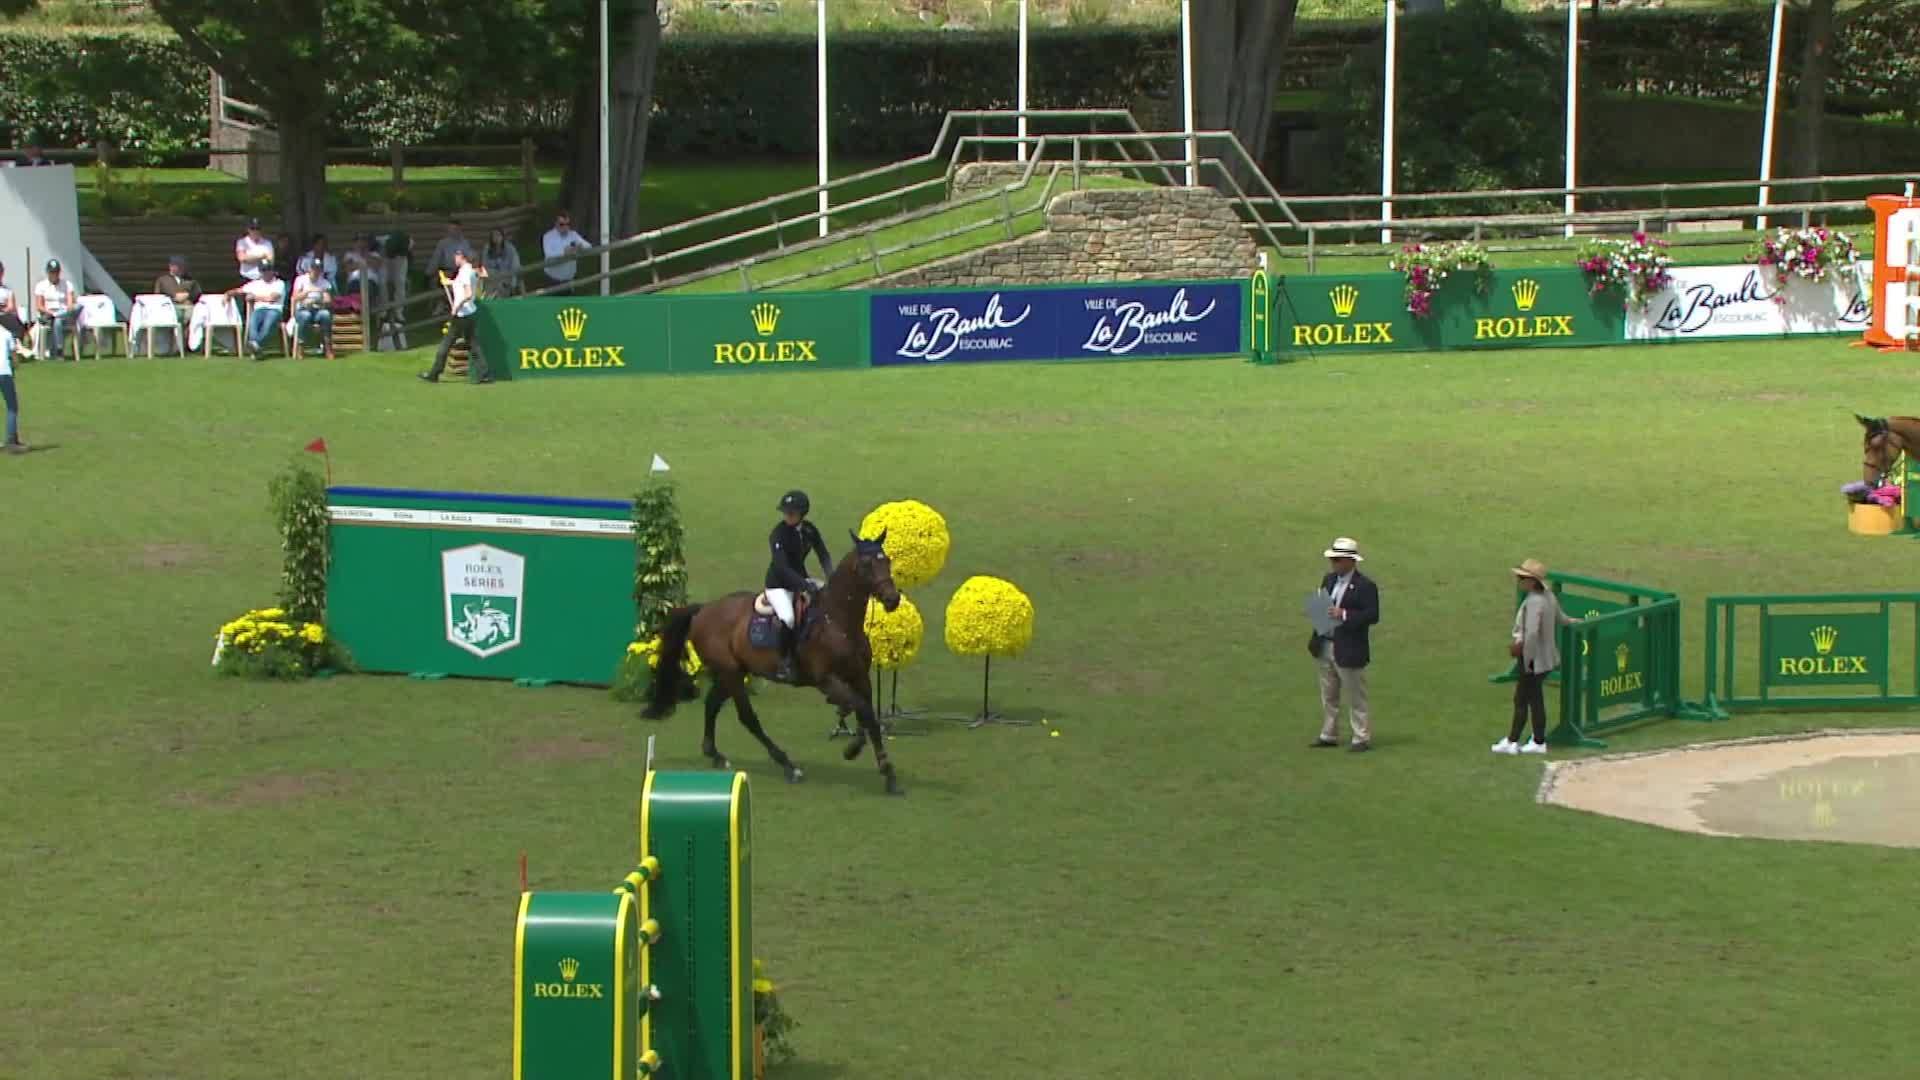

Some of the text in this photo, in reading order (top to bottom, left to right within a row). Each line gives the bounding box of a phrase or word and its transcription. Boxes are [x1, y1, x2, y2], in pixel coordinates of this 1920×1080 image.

[898, 304, 932, 316] VILLE DE
[1084, 298, 1118, 311] VILLE DE
[1653, 269, 1777, 333] La Baule
[896, 292, 1031, 361] La Baule
[1082, 287, 1216, 354] La Baule
[1474, 315, 1575, 340] ROLEX
[959, 337, 1013, 350] ESCOUBLAC
[1292, 322, 1394, 346] ROLEX
[519, 346, 625, 369] ROLEX
[714, 340, 817, 364] ROLEX
[465, 563, 503, 575] ROLEX
[463, 577, 504, 590] SERIES
[1779, 656, 1868, 676] ROLEX
[1600, 672, 1643, 697] ROLEX
[534, 983, 603, 999] ROLEX
